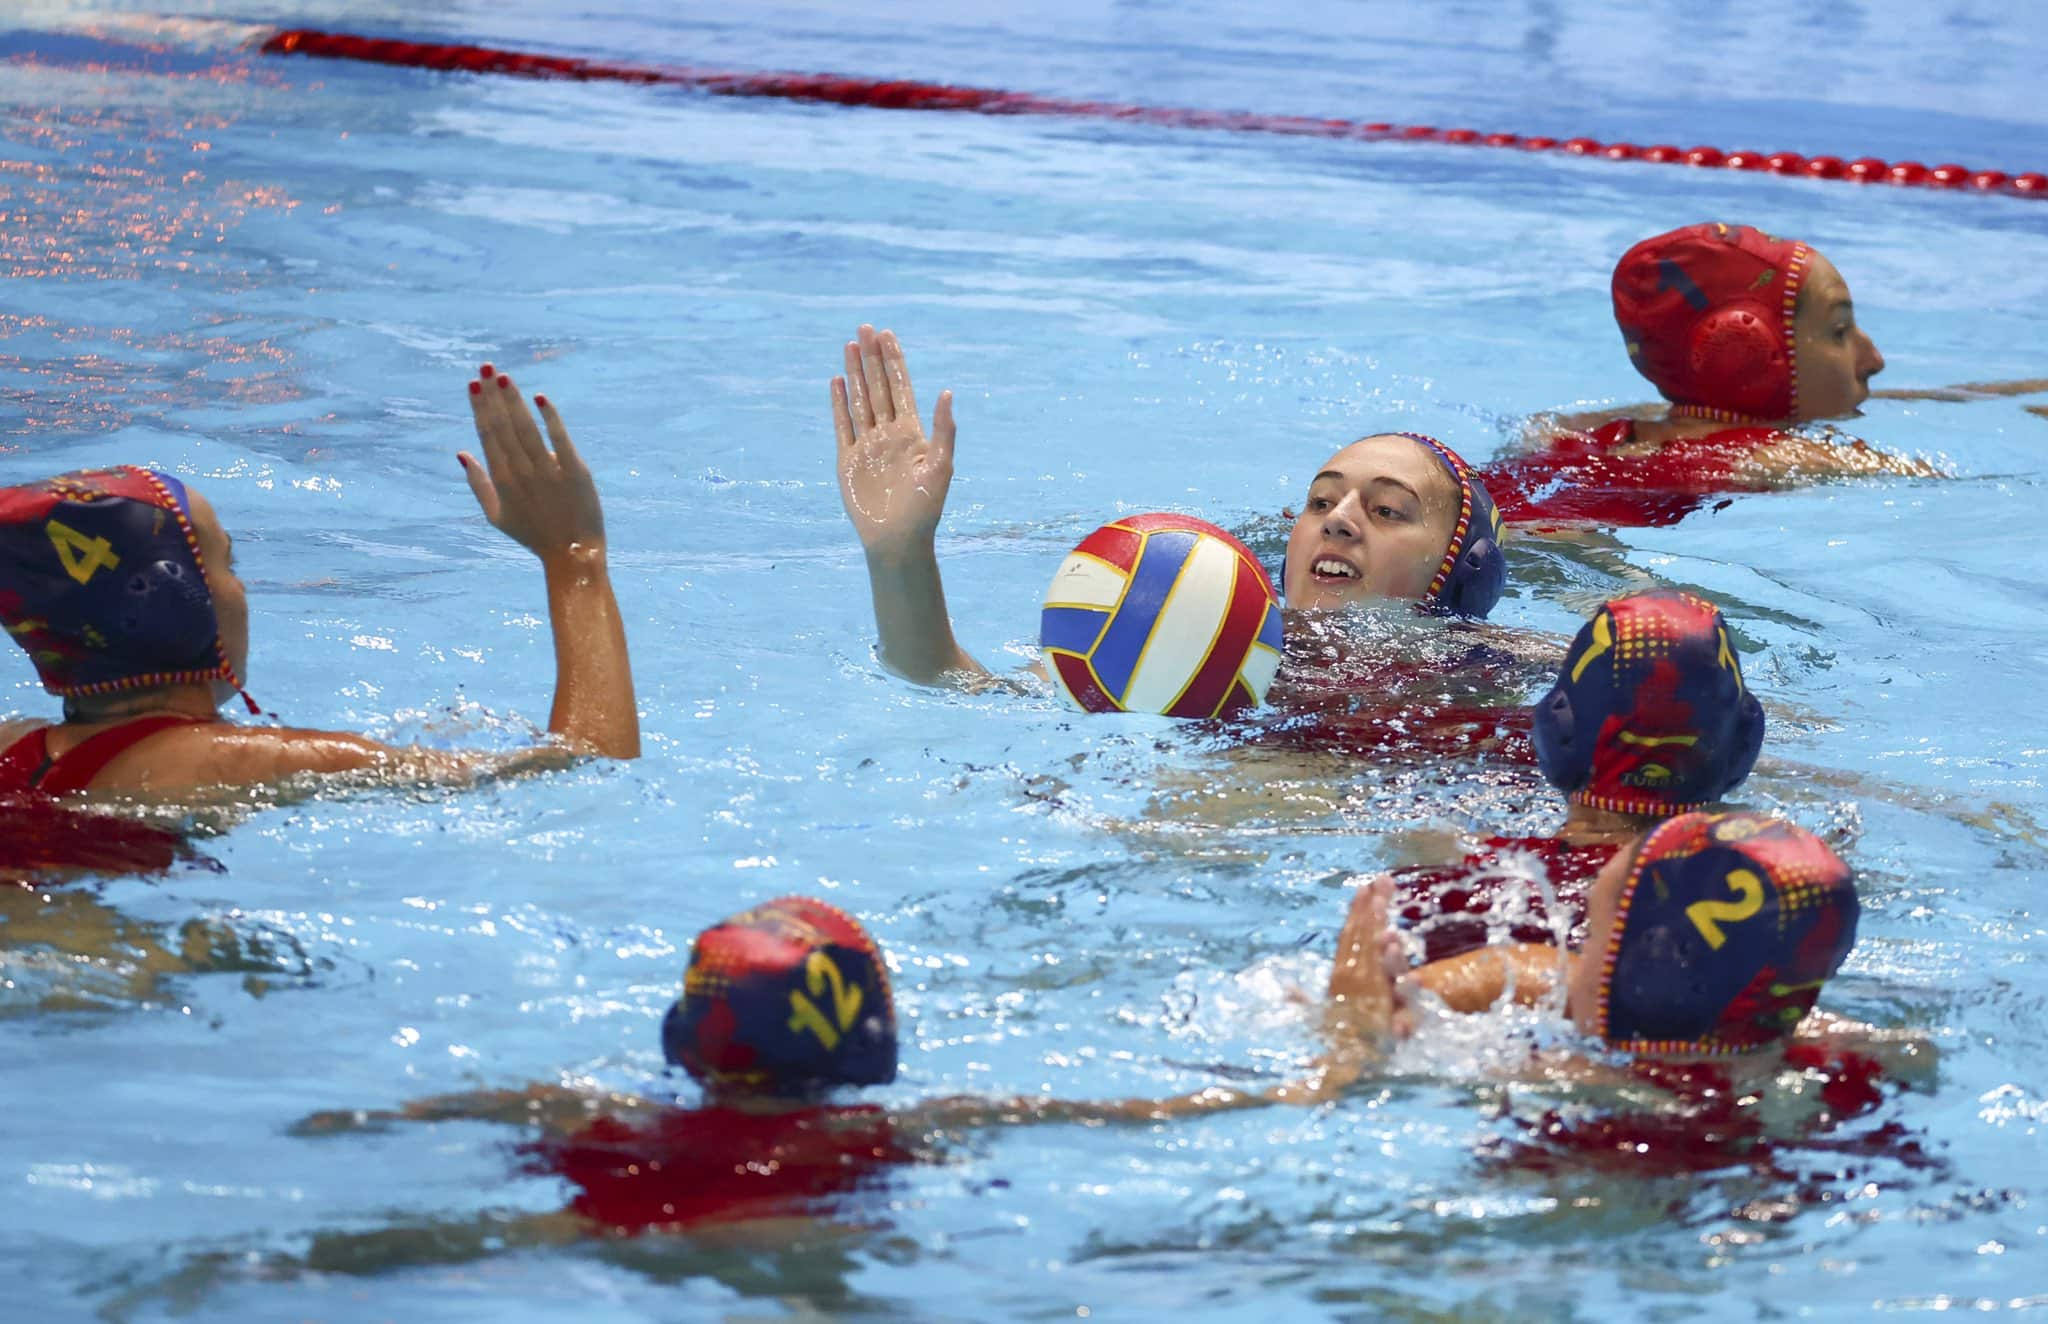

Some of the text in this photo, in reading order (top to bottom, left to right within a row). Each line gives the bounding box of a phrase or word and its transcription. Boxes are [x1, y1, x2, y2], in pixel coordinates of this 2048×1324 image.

[45, 519, 121, 585] 4
[1685, 868, 1765, 951] 2
[788, 952, 863, 1050] 12
